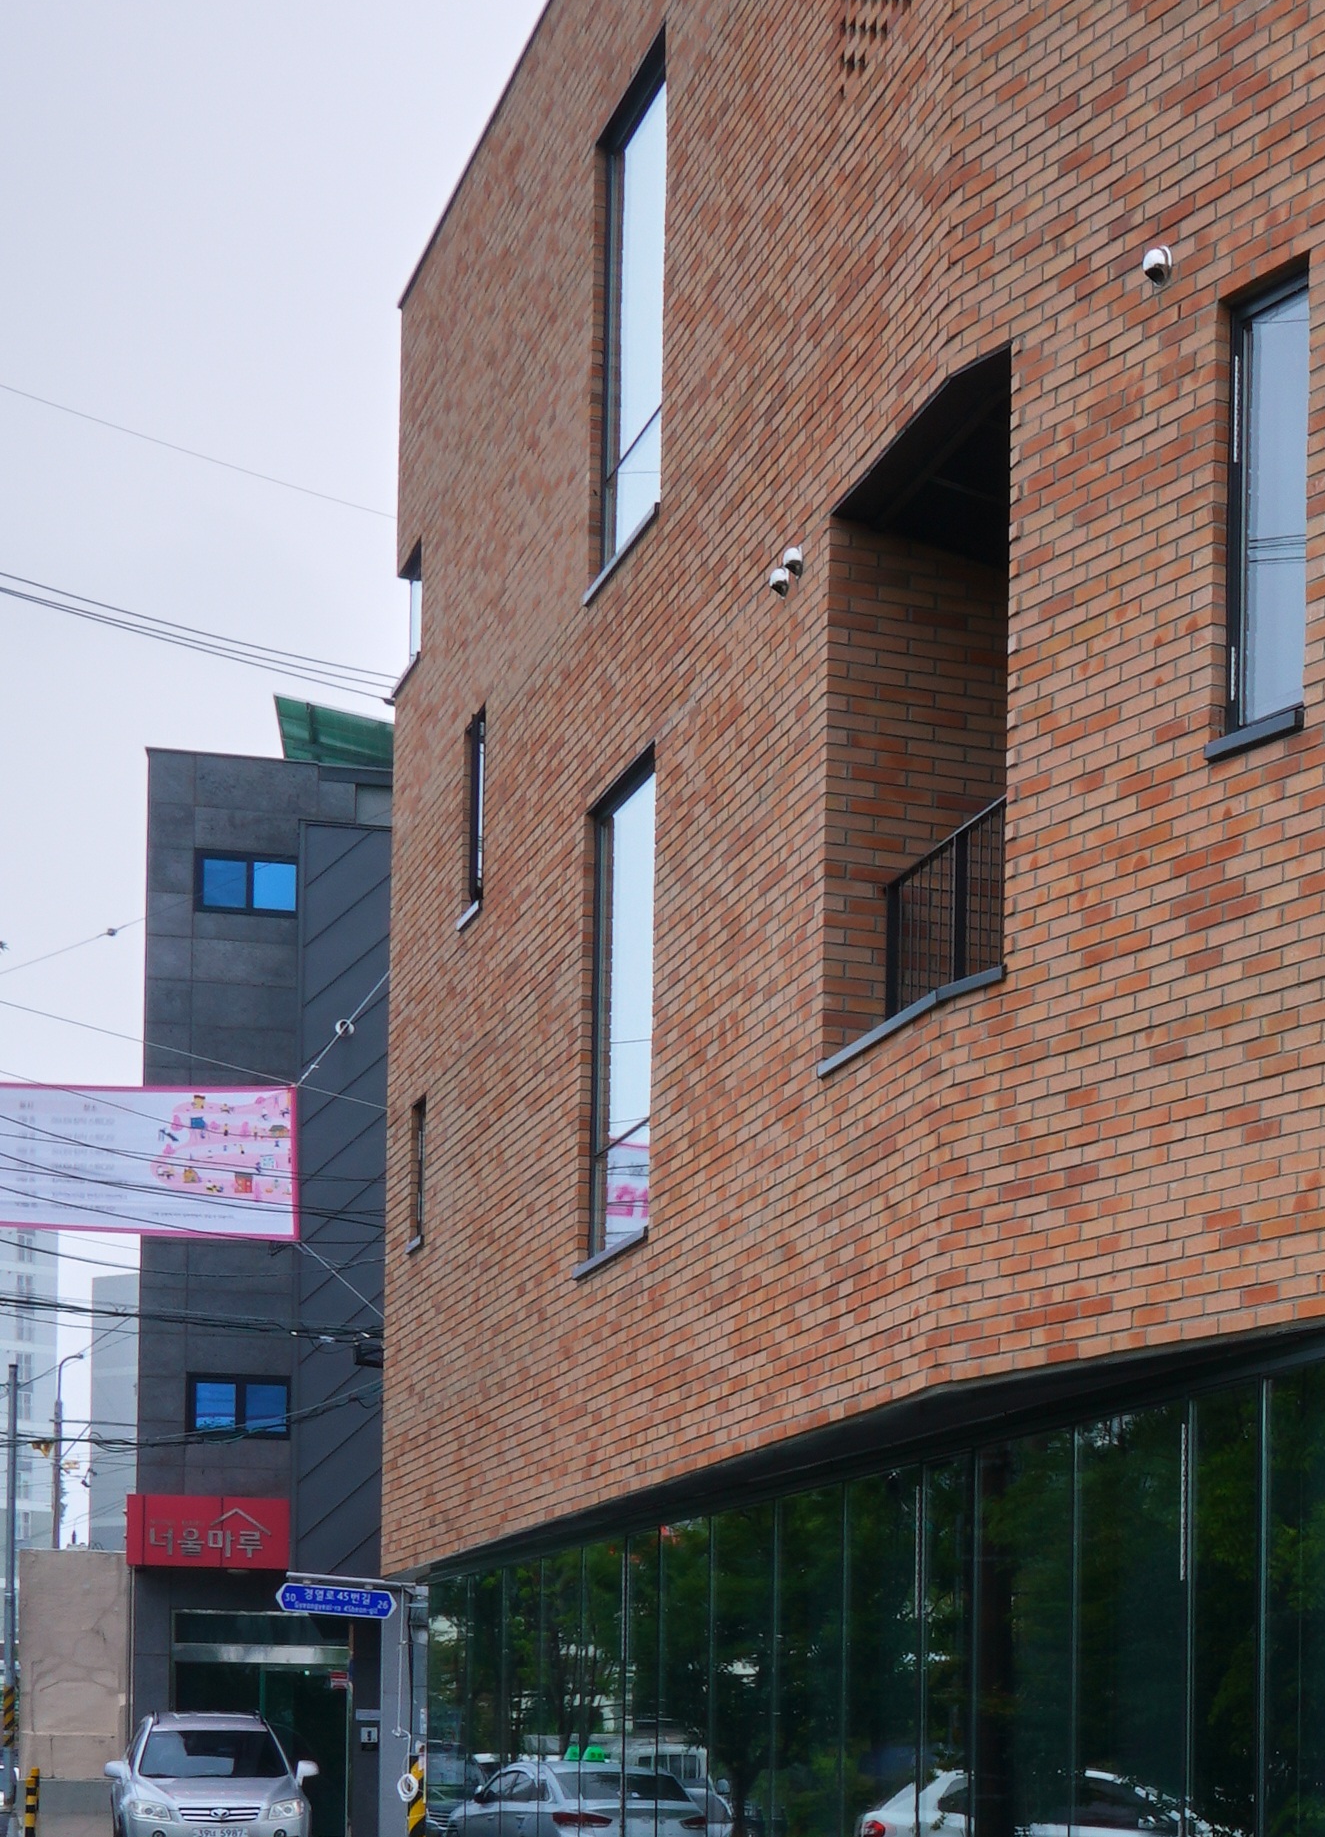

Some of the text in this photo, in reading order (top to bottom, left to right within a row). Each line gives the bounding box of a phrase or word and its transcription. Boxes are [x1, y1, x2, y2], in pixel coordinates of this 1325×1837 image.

[149, 1527, 264, 1558] 너울마루
[284, 1593, 297, 1602] 30
[377, 1600, 389, 1610] 26
[220, 1828, 244, 1837] 5987
